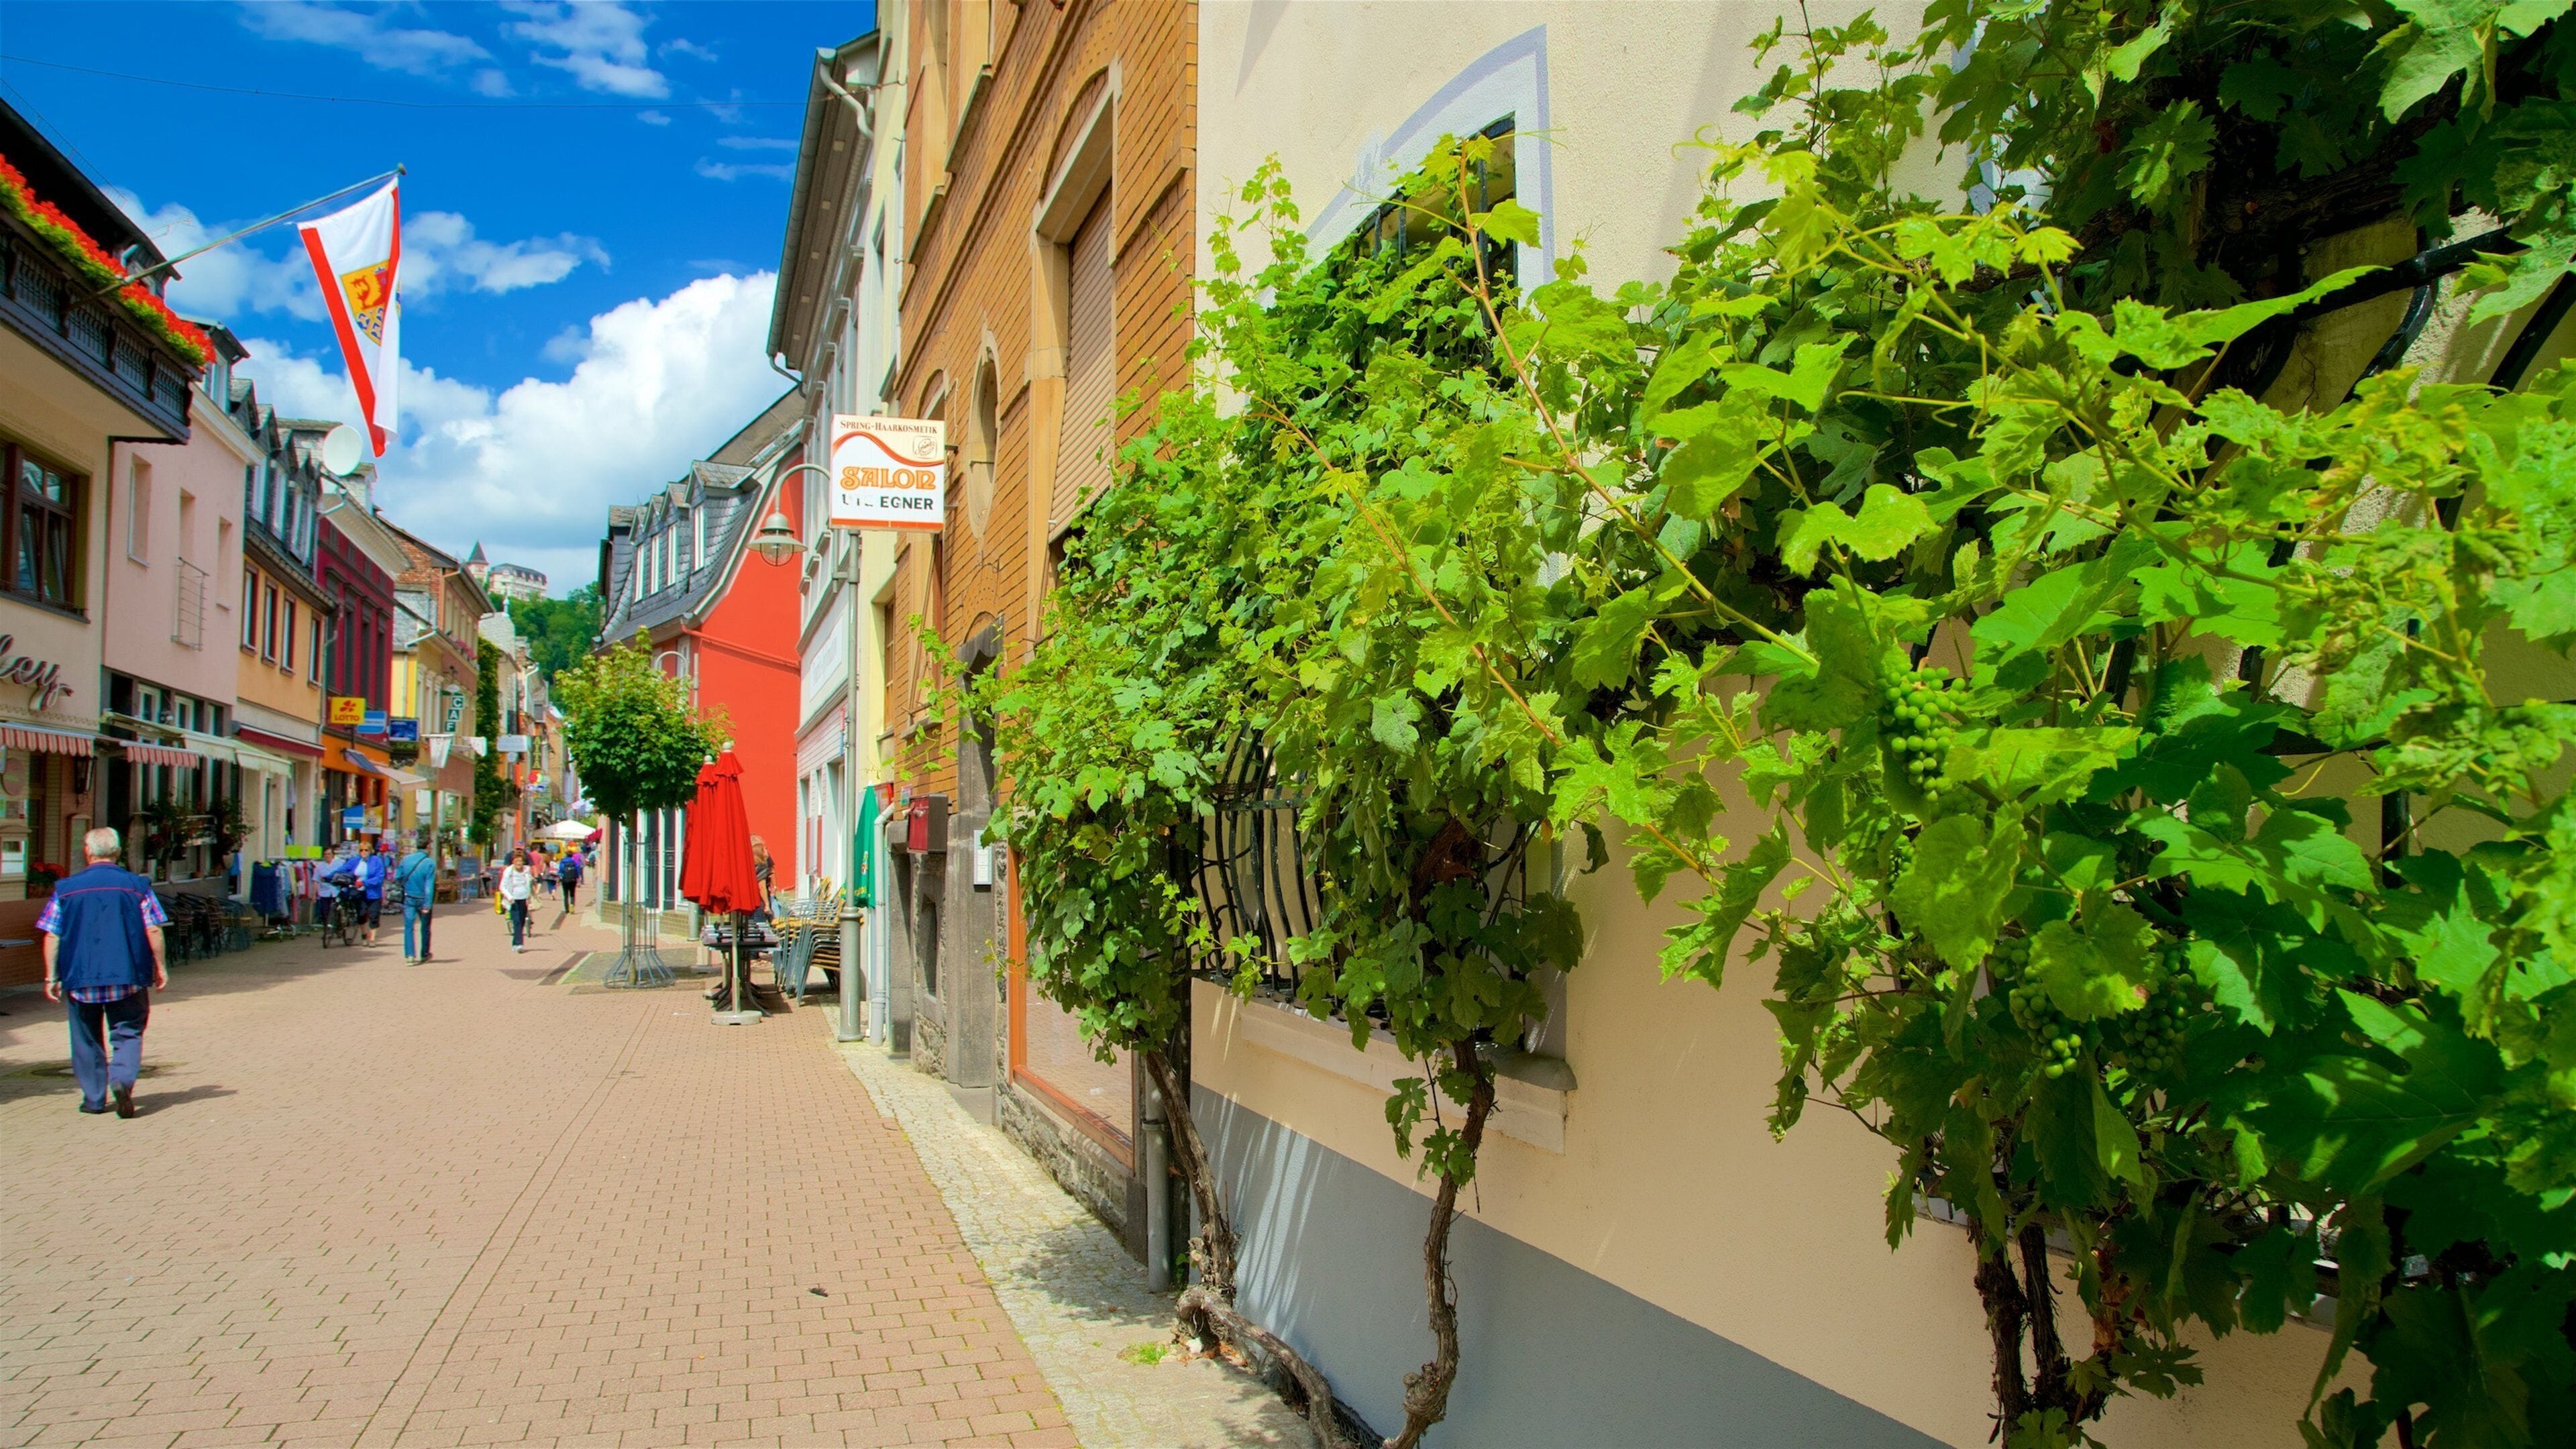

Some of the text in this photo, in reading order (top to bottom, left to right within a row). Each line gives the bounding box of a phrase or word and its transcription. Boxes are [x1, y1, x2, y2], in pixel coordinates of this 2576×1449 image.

[841, 466, 936, 490] SALON
[879, 496, 934, 510] EGNER
[447, 698, 463, 731] CAF
